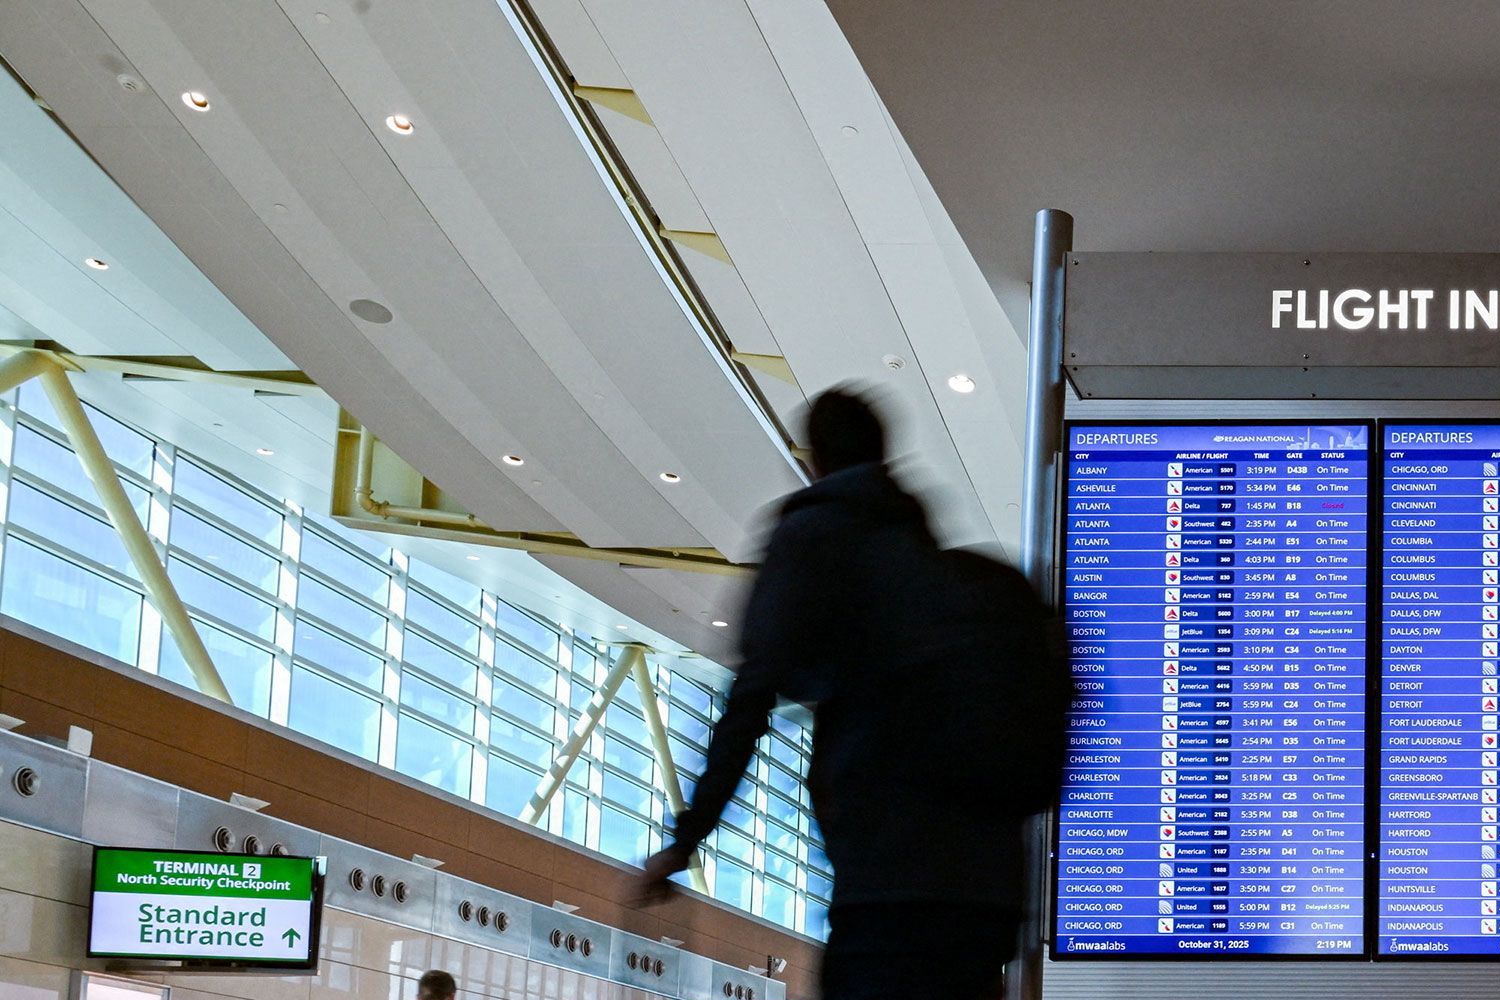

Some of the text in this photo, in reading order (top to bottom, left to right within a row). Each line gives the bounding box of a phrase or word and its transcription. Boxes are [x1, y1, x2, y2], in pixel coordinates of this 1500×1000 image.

[1272, 289, 1434, 330] FLIGHT
[1076, 433, 1159, 445] DEPARTURES
[1225, 435, 1295, 443] REAGAN NATIONAL
[1391, 432, 1473, 444] DEPARTURES
[1075, 452, 1090, 460] CITY
[1176, 452, 1201, 460] AIRLINE
[1206, 452, 1229, 460] FLIGHT
[1254, 452, 1270, 460] TIME
[1286, 452, 1303, 460] GATE
[1320, 451, 1345, 459] STATUS
[1389, 451, 1405, 459] CITY
[1076, 467, 1108, 475] ALBANY
[1247, 466, 1263, 474] 3:19
[1264, 466, 1277, 474] PM
[1287, 466, 1308, 474] D43B
[1316, 466, 1329, 474] On
[1330, 466, 1349, 474] Time
[1076, 484, 1116, 492] ASHEVILLE
[1391, 483, 1437, 491] CINCINNATI
[1075, 502, 1111, 510] ATLANTA
[1391, 519, 1436, 527] CLEVELAND
[1391, 537, 1433, 545] COLUMBIA
[1390, 555, 1436, 563] COLUMBUS
[1073, 574, 1103, 582] AUSTIN
[1073, 592, 1107, 600] BANGOR
[1390, 591, 1439, 600] DALLAS, DAL
[1073, 610, 1106, 618] BOSTON
[1390, 646, 1423, 654] DAYTON
[1389, 682, 1423, 690] DETROIT
[1071, 719, 1106, 727] BUFFALO
[1389, 718, 1462, 727] FORT LAUDERDALE
[1070, 737, 1122, 745] BURLINGTON
[1069, 755, 1121, 763] CHARLESTON
[1388, 755, 1447, 764] GRAND RAPIDS
[1388, 774, 1443, 782] GREENSBORO
[1068, 792, 1114, 800] CHARLOTTE
[1388, 792, 1479, 801] GREENVILLE-SPARTANB
[1388, 811, 1431, 819] HARTFORD
[1067, 829, 1105, 837] CHICAGO,
[1106, 829, 1129, 837] MDW
[1241, 829, 1258, 837] 2:55
[1281, 829, 1293, 837] A5
[1312, 829, 1324, 837] On
[1325, 829, 1345, 837] Time
[153, 860, 239, 877] TERMINAL
[117, 873, 291, 892] North Security Checkpoint
[1388, 885, 1436, 893] HUNTSVILLE
[1387, 904, 1444, 912] INDIANAPOLIS
[138, 903, 266, 927] Standard
[1065, 921, 1123, 930] CHICAGO, ORD
[139, 924, 265, 947] Entrance
[1075, 940, 1126, 951] mwaalabs
[1178, 939, 1250, 951] October 31, 2025
[1316, 939, 1352, 949] 2:19 PM
[1397, 941, 1449, 951] mwaalabs
